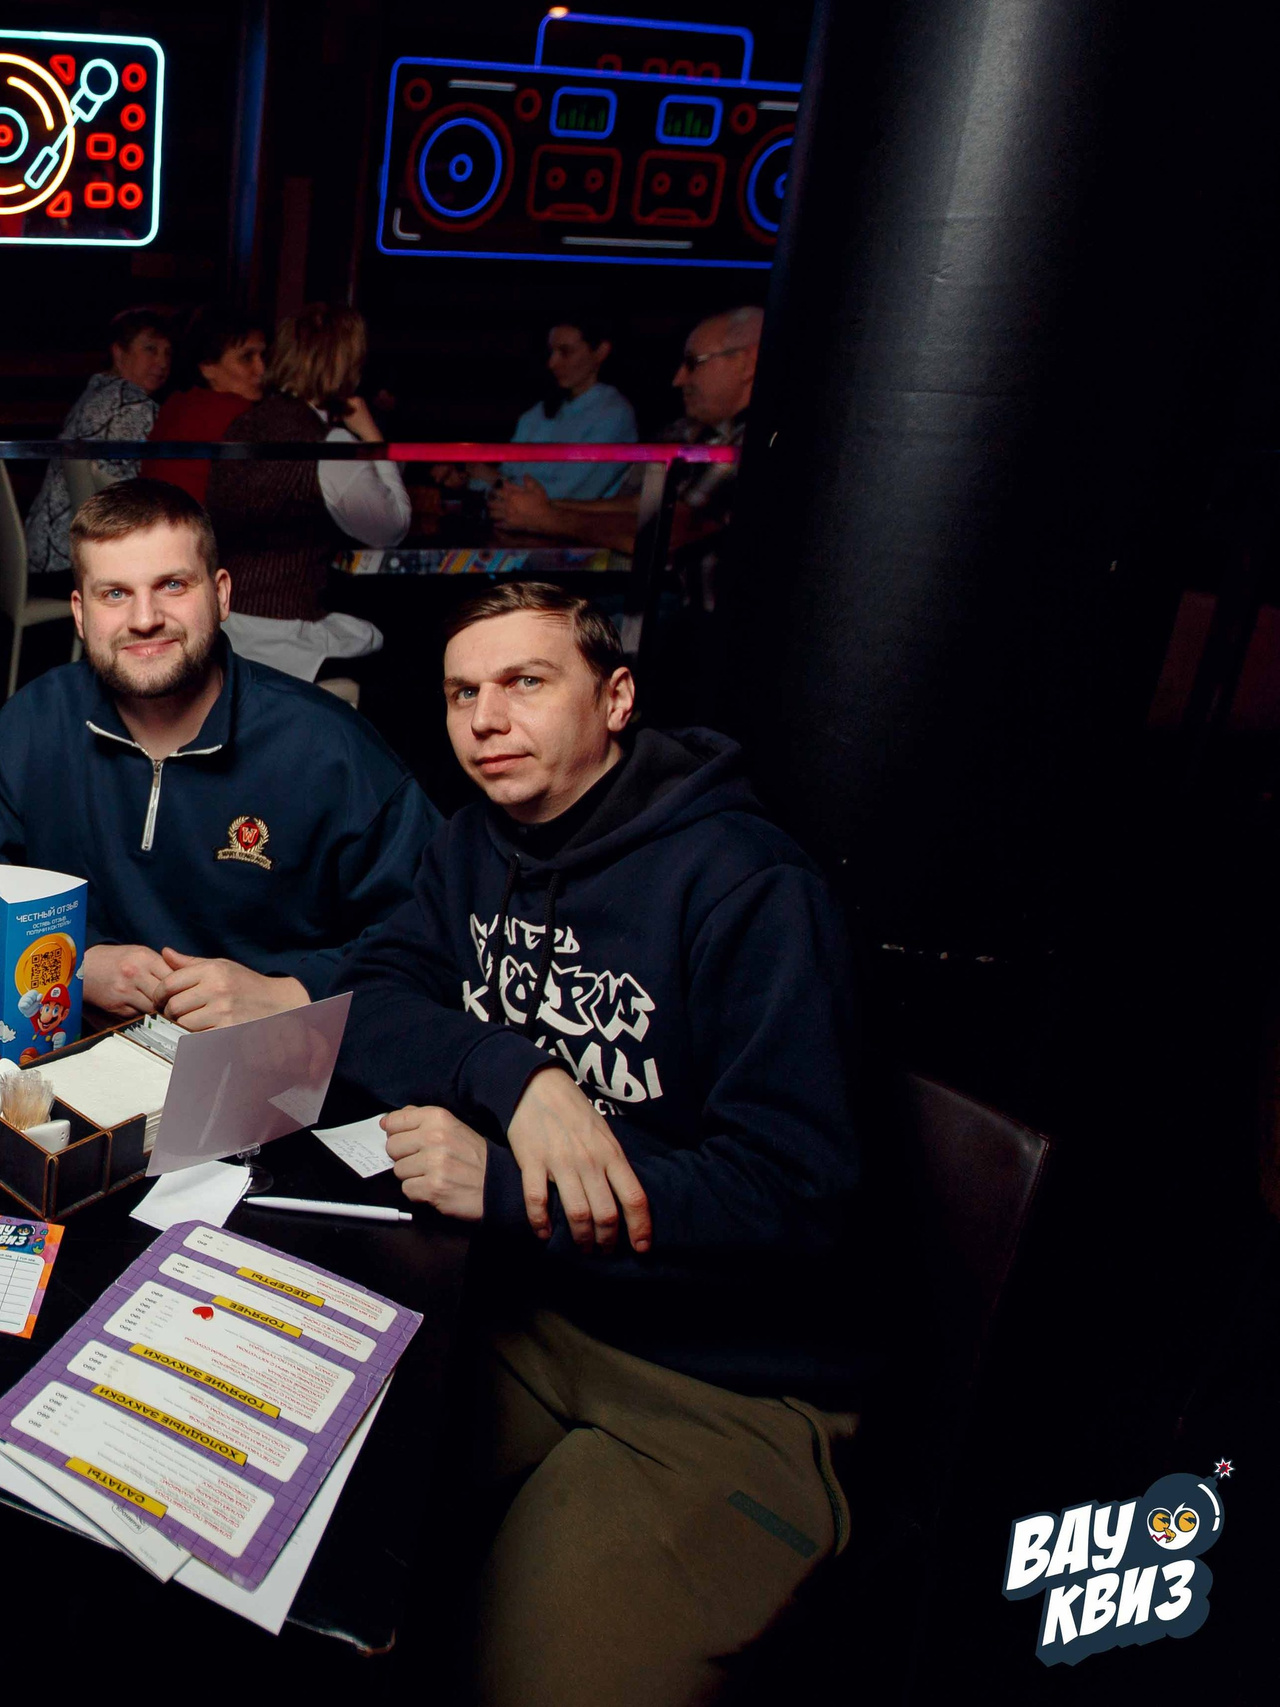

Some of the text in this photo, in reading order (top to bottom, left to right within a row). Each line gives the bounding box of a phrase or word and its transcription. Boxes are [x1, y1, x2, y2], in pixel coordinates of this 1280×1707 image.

[242, 826, 257, 843] W
[16, 900, 79, 922] ЧЕСТНЫЙ ОТЗЫВ
[251, 1272, 310, 1300] ДЕСЕРТЫ
[228, 1302, 285, 1329] ГОРЯЧЕЕ
[143, 1349, 202, 1380] ЗАКУСКИ
[99, 1387, 159, 1422] ЗАКУСКИ
[204, 1375, 264, 1409] ГОРЯЧИЕ
[160, 1415, 239, 1459] ХОЛОДНЫЕ
[86, 1467, 145, 1504] САЛАТЫ
